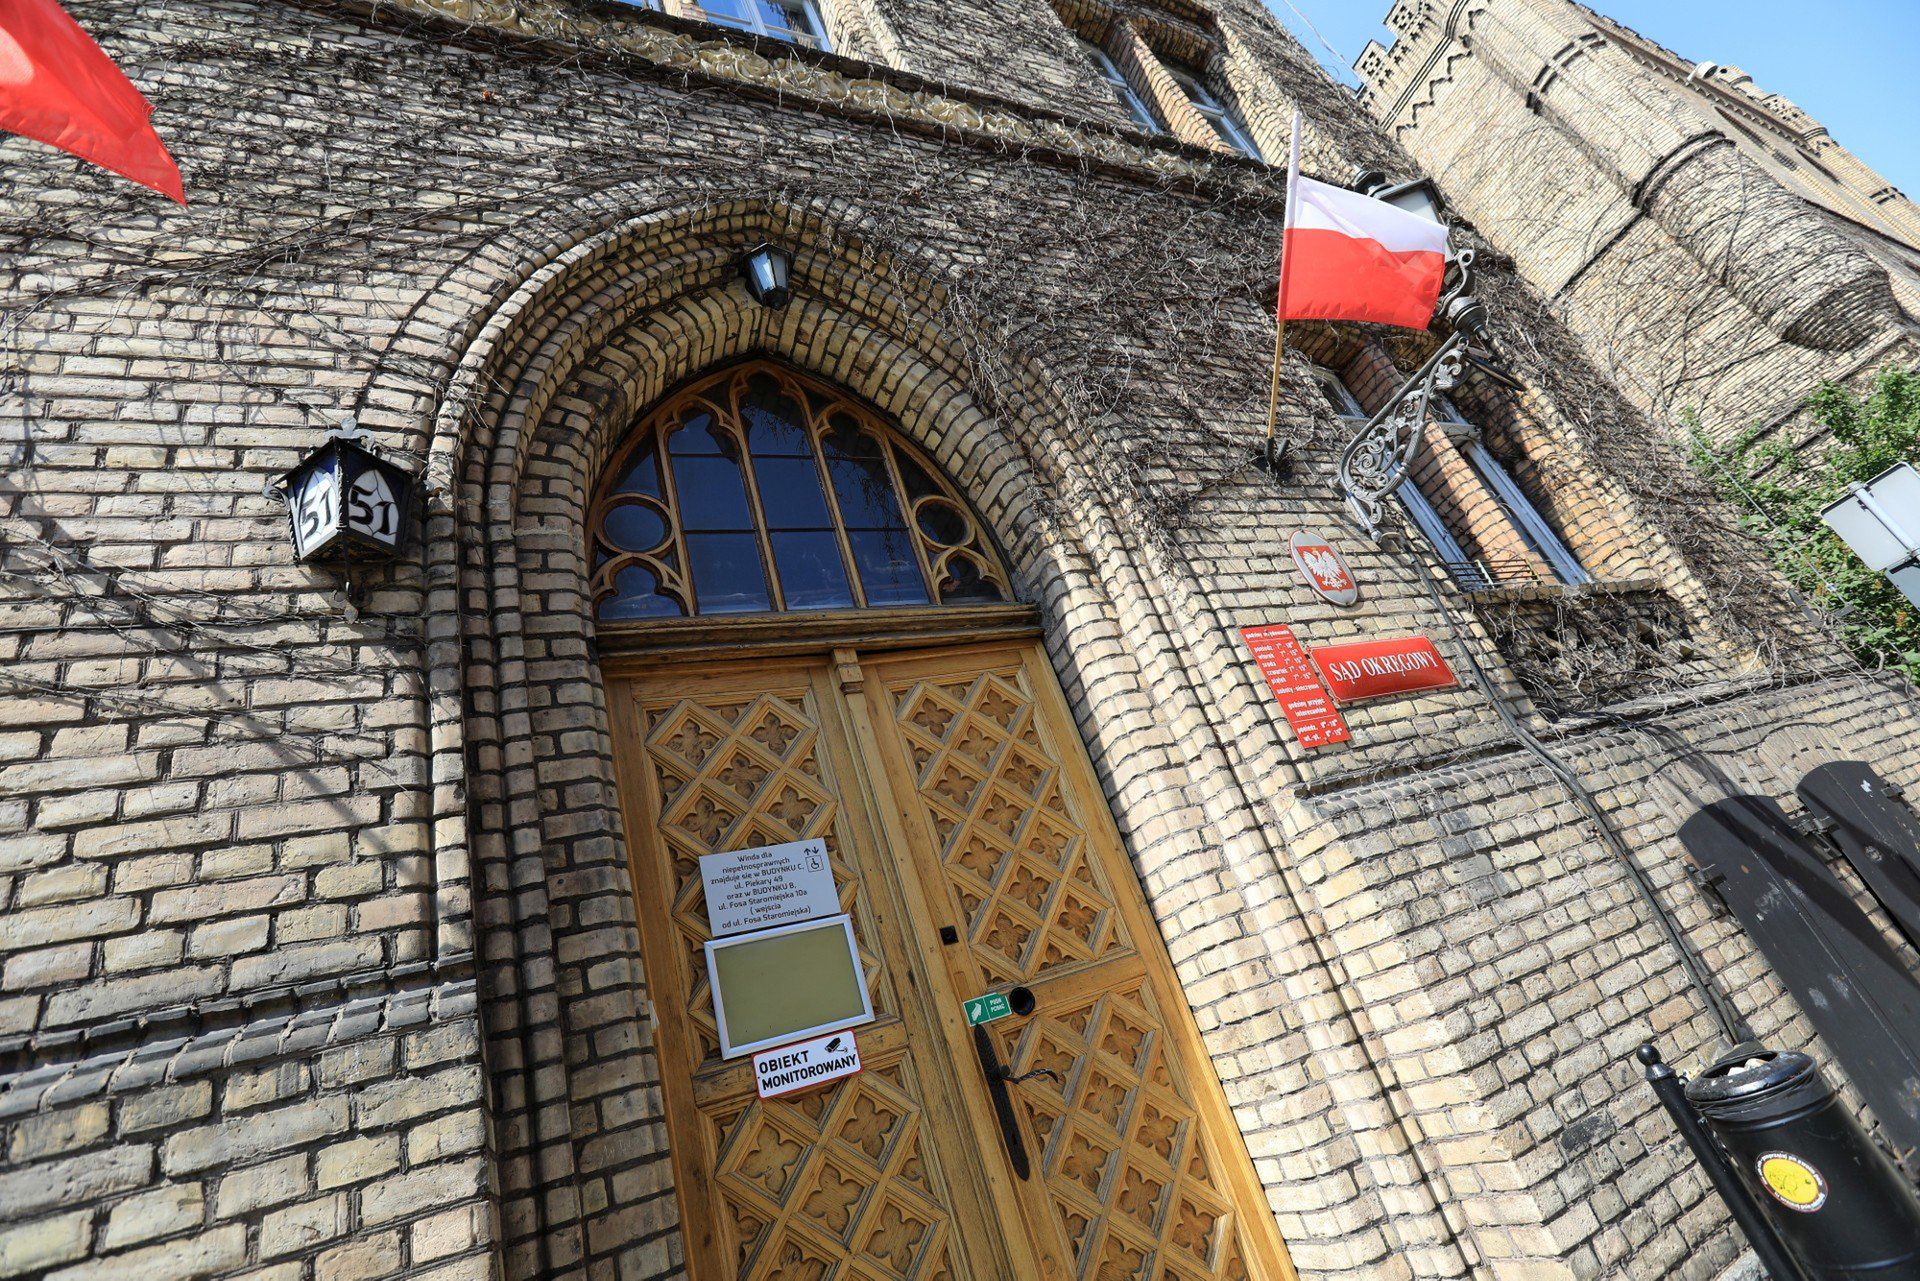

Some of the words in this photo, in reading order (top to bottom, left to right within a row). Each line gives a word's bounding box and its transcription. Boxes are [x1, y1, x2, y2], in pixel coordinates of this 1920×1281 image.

[301, 486, 332, 541] 51
[349, 484, 391, 536] 51
[1329, 660, 1362, 685] SĄD
[1360, 650, 1438, 677] OKRĘGOWY
[722, 857, 790, 874] niepełnosprawnych
[737, 853, 760, 863] Winda
[761, 852, 772, 860] dla
[710, 873, 740, 886] znajduje
[742, 872, 752, 880] się
[761, 865, 797, 877] BUDYNKU
[734, 882, 744, 890] ul.
[746, 878, 772, 888] Piekary
[774, 875, 784, 884] 49
[718, 903, 728, 912] ul.
[729, 900, 748, 910] Fosa
[748, 892, 794, 907] Staromiejska
[796, 890, 808, 898] 10a
[726, 892, 743, 900] oraz
[752, 884, 788, 896] BUDYNKU
[722, 921, 732, 930] od
[732, 918, 742, 926] ul.
[744, 915, 762, 925] Fosa
[762, 905, 811, 920] Staromiejska)
[759, 1050, 809, 1074] OBIEKT
[762, 1054, 856, 1091] MONITOROWANY
